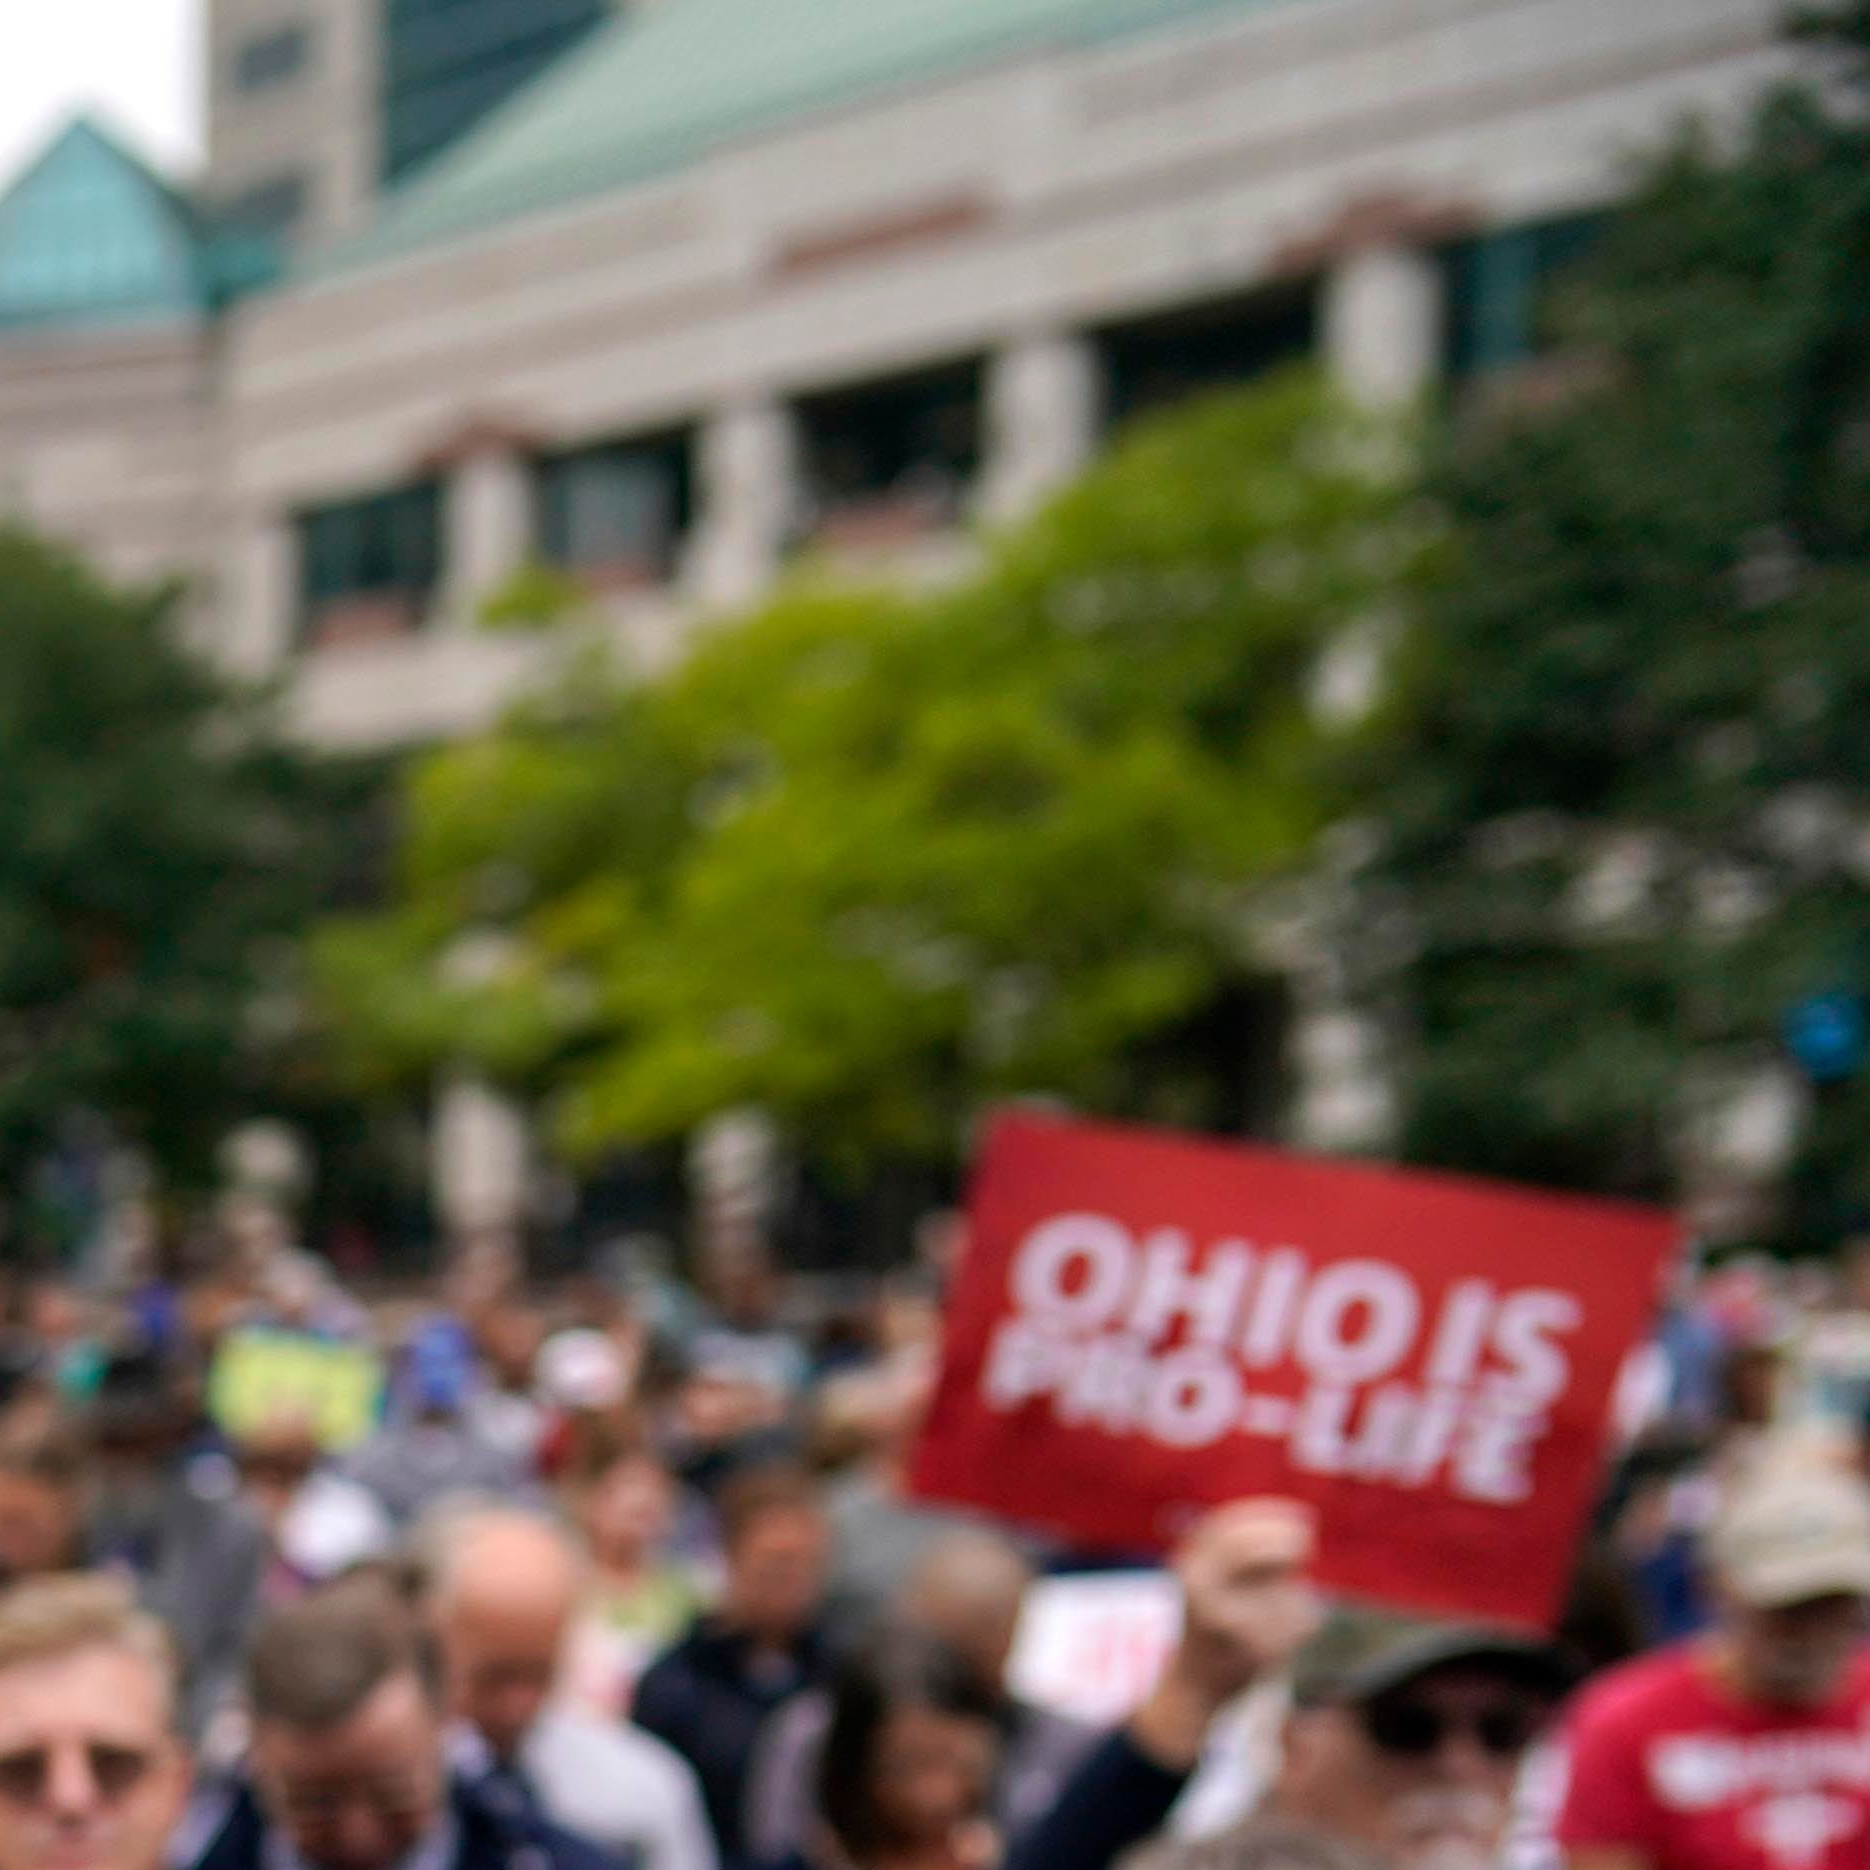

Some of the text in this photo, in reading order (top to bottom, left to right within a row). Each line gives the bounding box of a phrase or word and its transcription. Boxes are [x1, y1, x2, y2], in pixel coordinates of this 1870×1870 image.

[981, 1312, 1550, 1506] PRO-LIFE
[1010, 1212, 1585, 1410] OHIO IS
